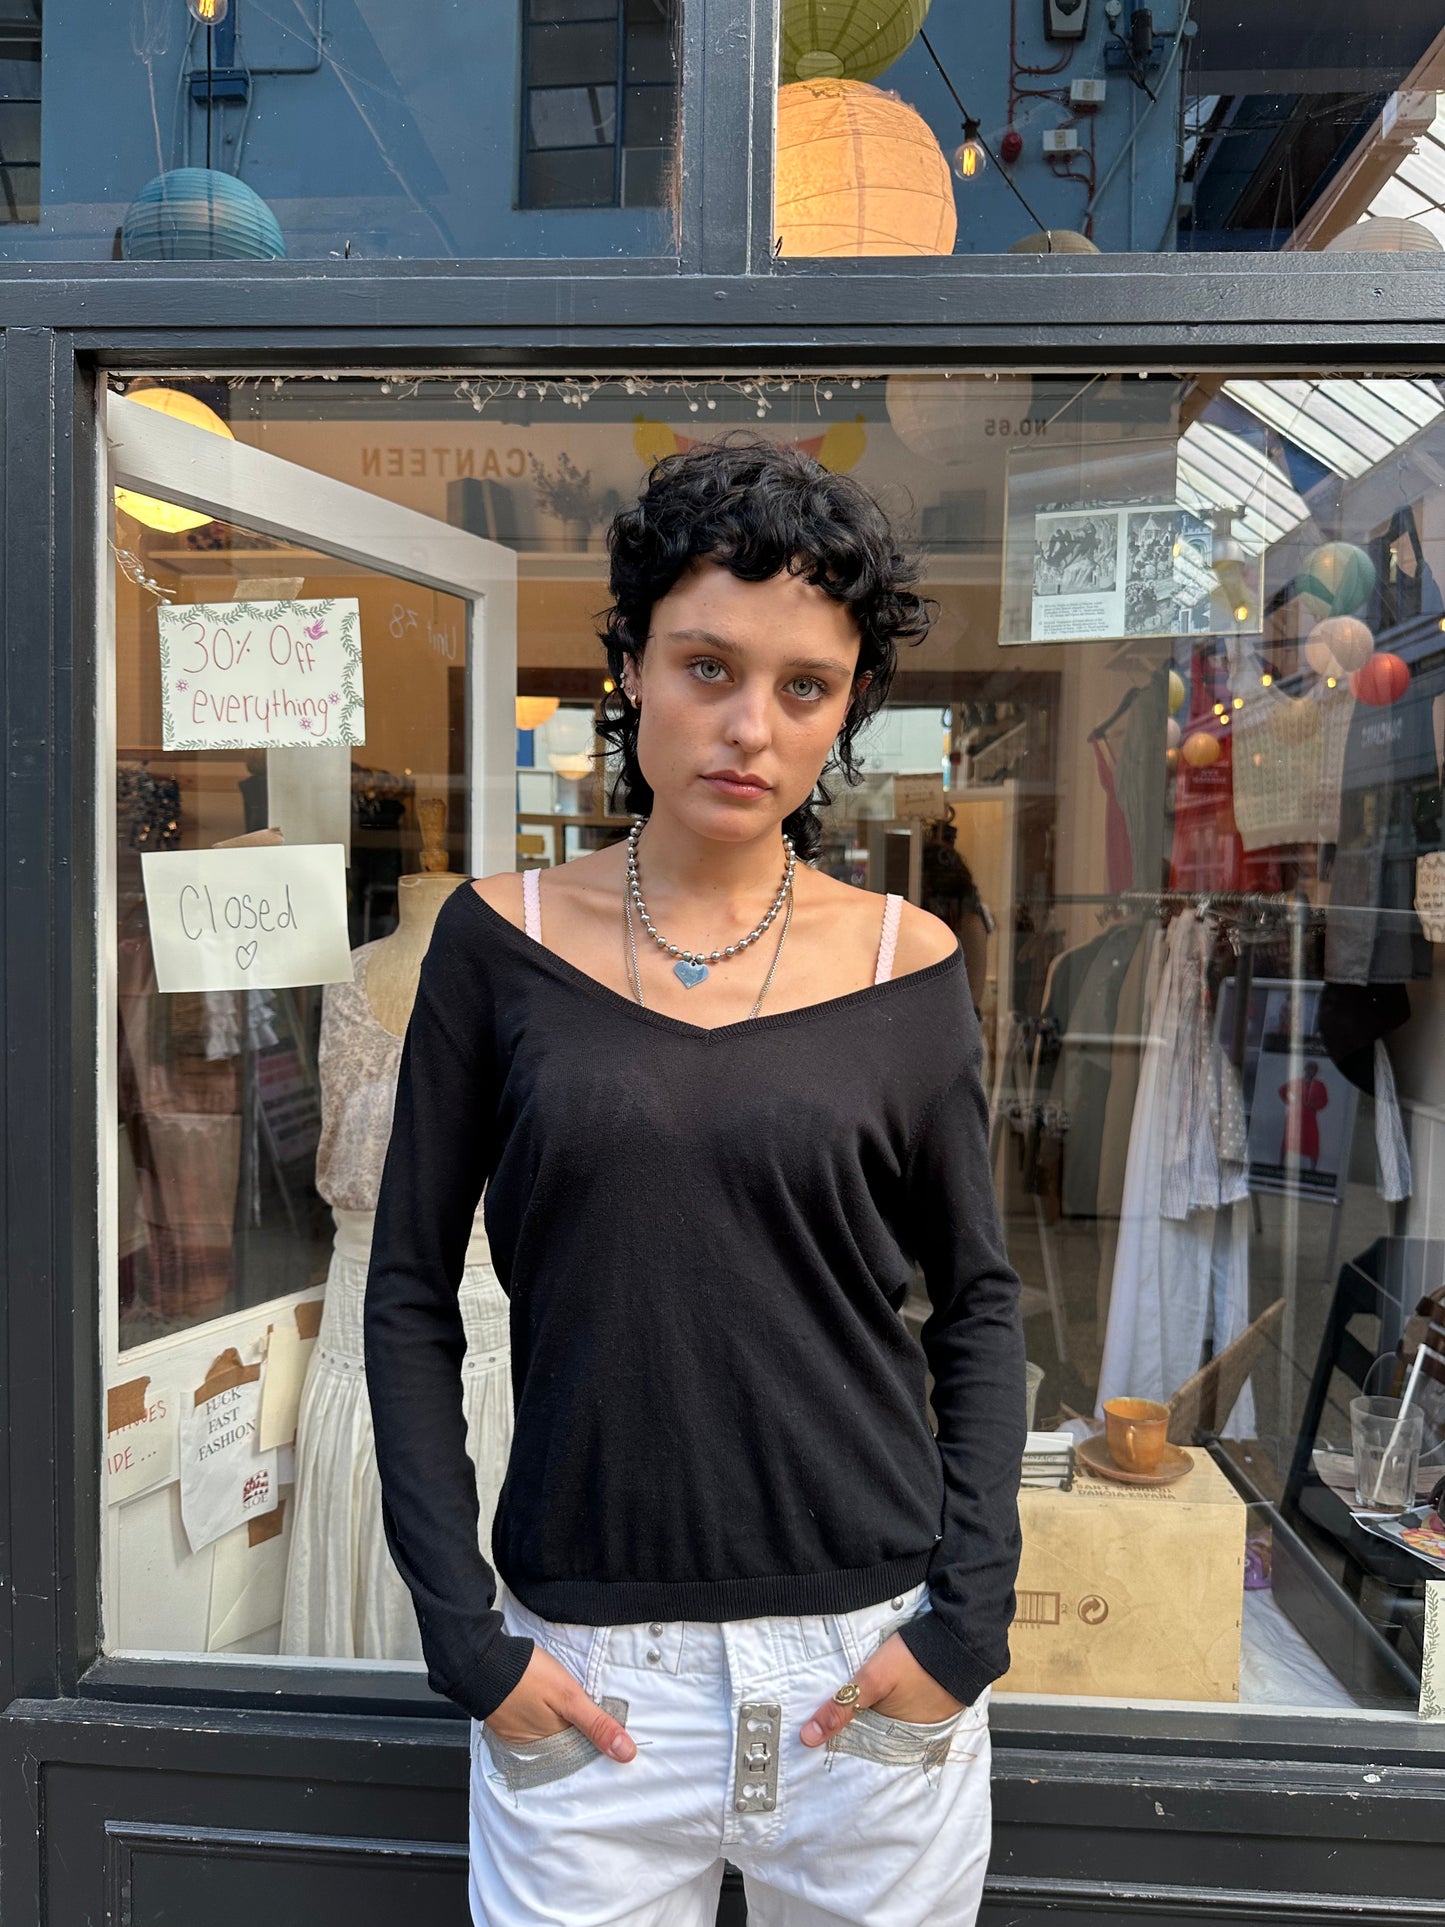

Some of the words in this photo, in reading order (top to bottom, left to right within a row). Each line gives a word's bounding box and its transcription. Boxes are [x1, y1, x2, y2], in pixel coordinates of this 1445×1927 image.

[181, 622, 253, 673] 30%
[269, 624, 316, 674] Off
[192, 688, 330, 737] everything
[179, 884, 299, 941] Closed
[205, 1387, 242, 1416] FUCK
[208, 1406, 240, 1434] FAST
[198, 1419, 257, 1461] FASHION
